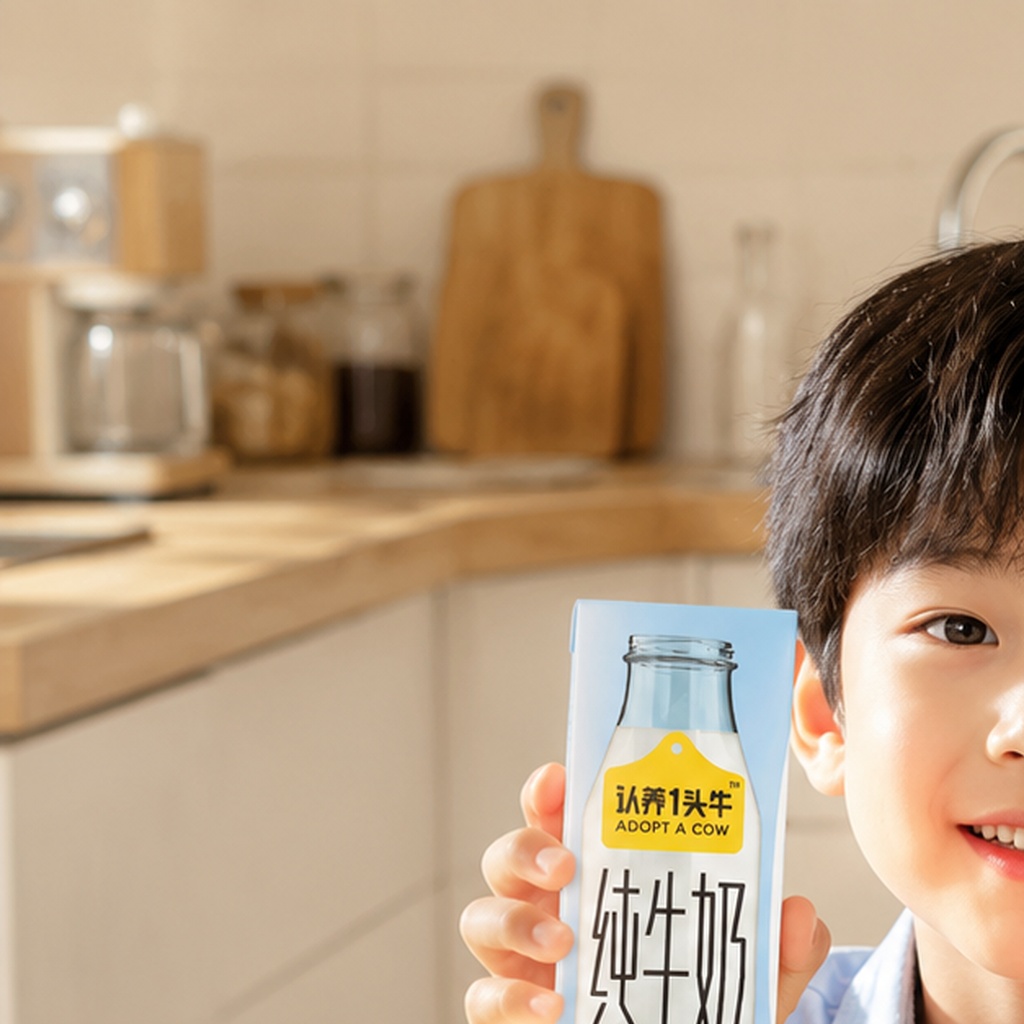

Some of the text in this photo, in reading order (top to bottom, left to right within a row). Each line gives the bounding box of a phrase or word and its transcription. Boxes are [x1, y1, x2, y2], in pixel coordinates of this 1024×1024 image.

[616, 785, 732, 818] 认养1头牛
[615, 820, 730, 836] ADOPT A COW
